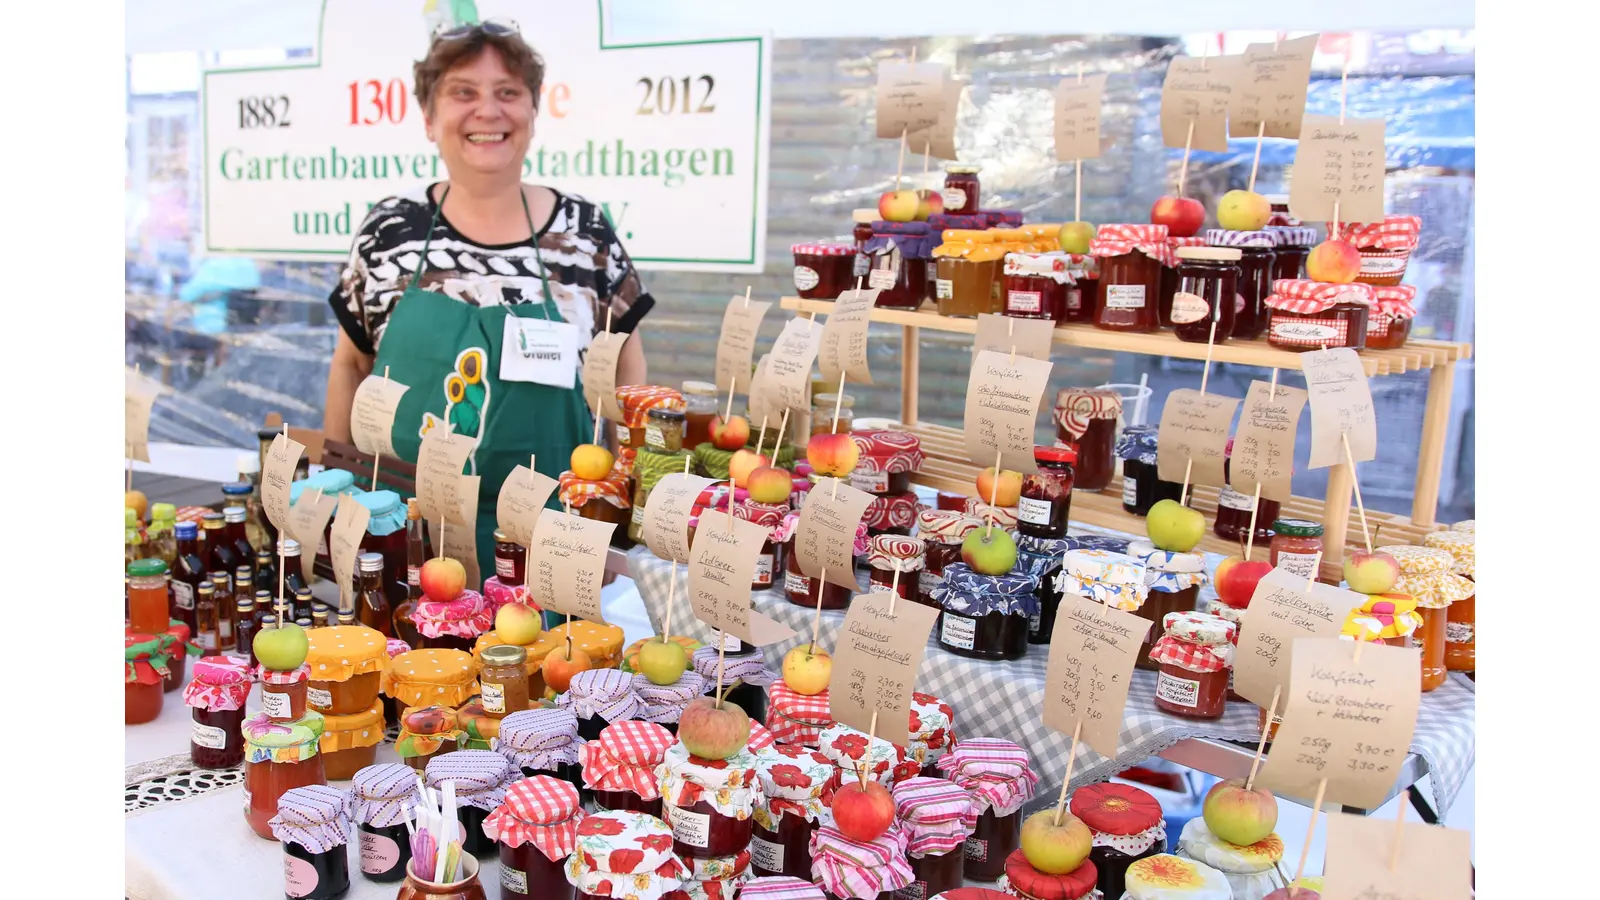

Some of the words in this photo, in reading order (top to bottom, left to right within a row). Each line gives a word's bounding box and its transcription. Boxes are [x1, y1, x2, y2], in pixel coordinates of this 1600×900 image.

[238, 95, 291, 130] 1882
[347, 78, 407, 126] 130
[635, 74, 716, 115] 2012
[220, 146, 439, 181] Gartenbauver
[293, 202, 350, 235] und
[1265, 588, 1334, 621] Apfelkonfitüre
[1258, 632, 1282, 654] 300g
[1256, 647, 1279, 667] 200g
[896, 682, 903, 690] €
[1066, 668, 1081, 686] 300g
[1111, 674, 1119, 682] €
[876, 686, 893, 701] 2,30
[893, 693, 902, 701] €
[1063, 681, 1081, 700] 250g
[1061, 695, 1076, 716] 200g
[1086, 707, 1102, 720] 2,60
[1301, 737, 1332, 753] 250g
[1383, 748, 1395, 757] €
[1296, 753, 1327, 771] 220g
